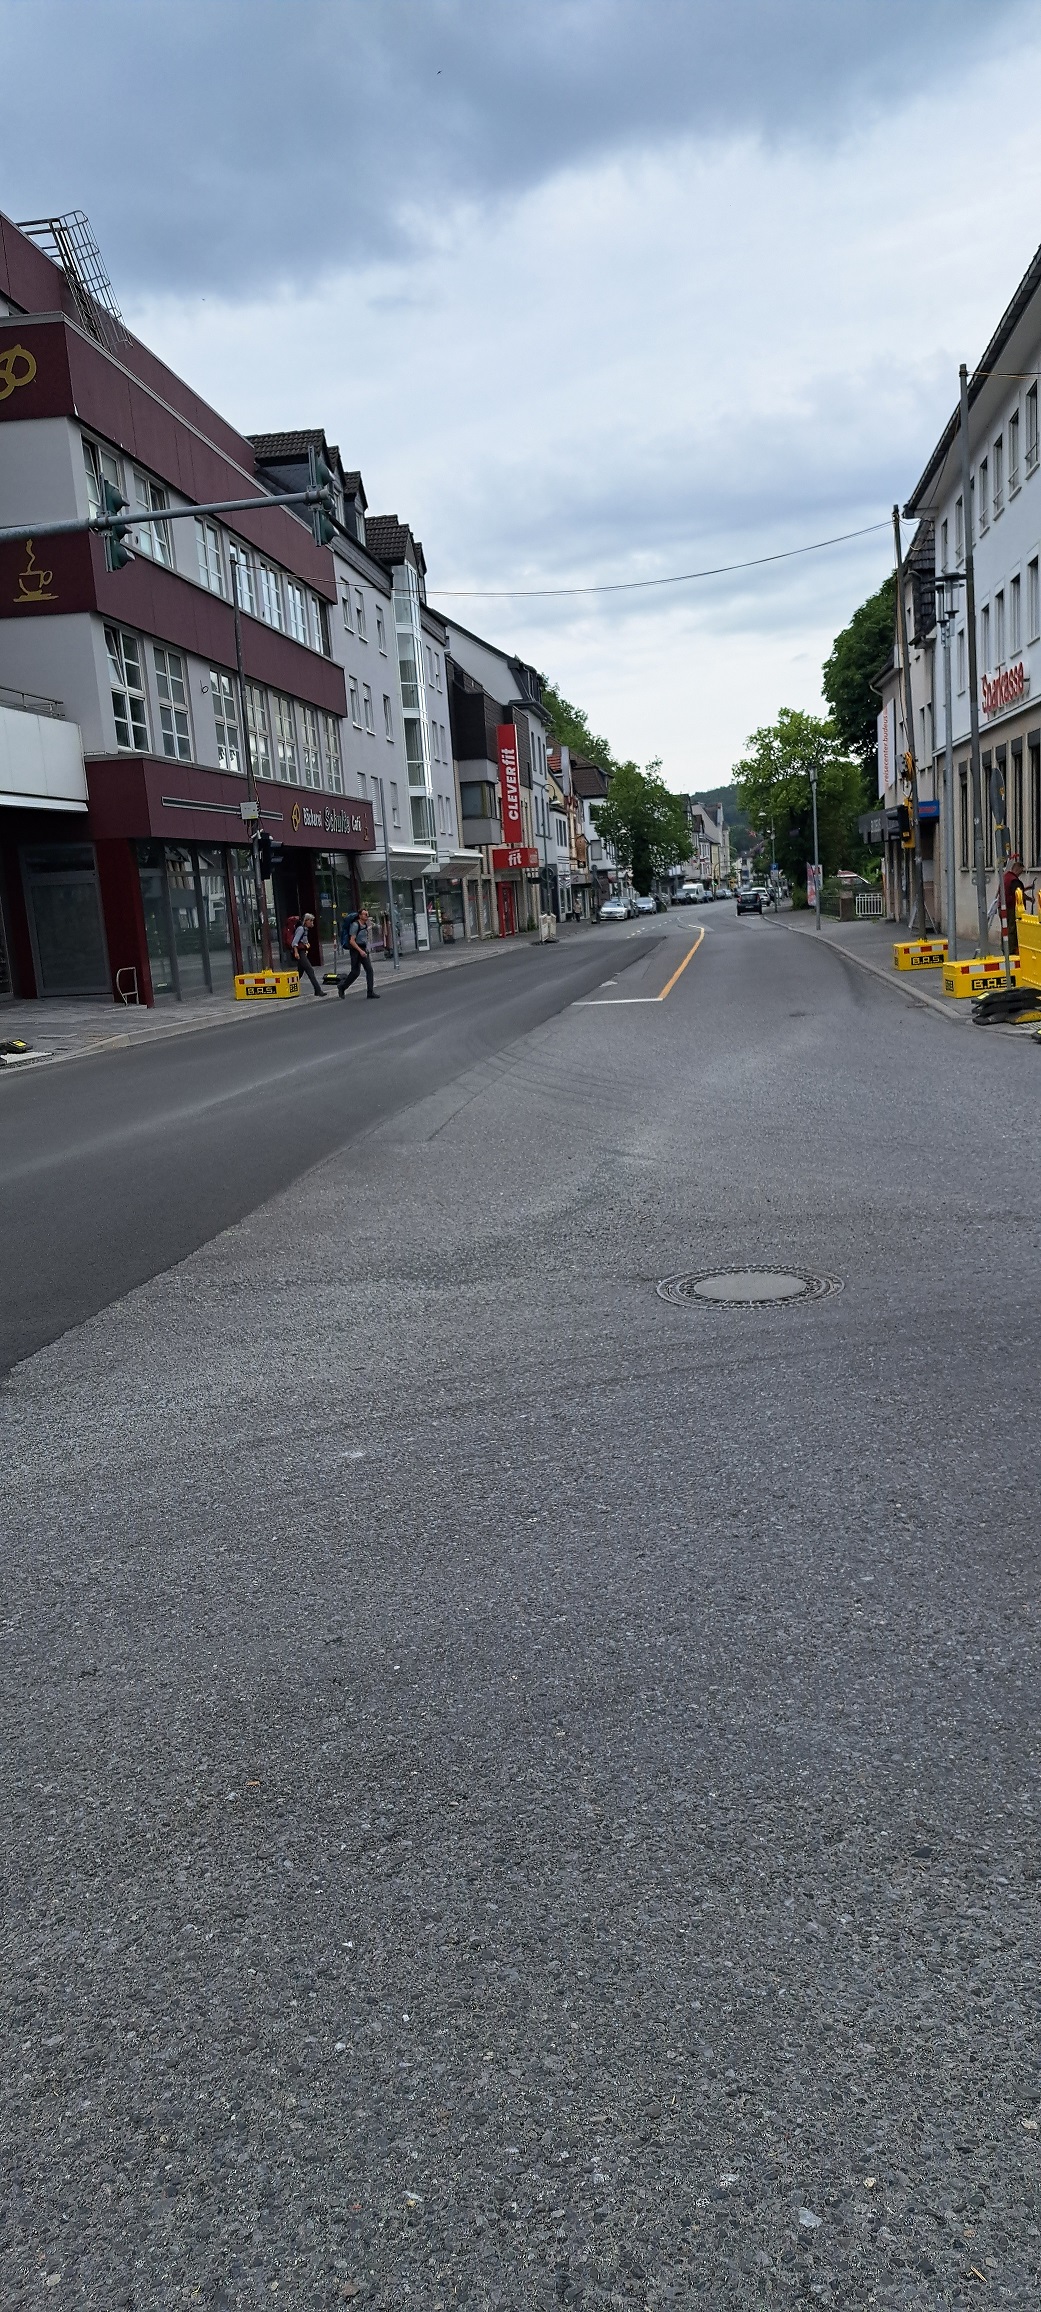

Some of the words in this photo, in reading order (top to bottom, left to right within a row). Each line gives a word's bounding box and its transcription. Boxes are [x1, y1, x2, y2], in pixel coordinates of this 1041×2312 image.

[981, 662, 1024, 716] Sparkasse
[508, 853, 522, 867] fit
[912, 955, 943, 965] B.A.S.
[247, 986, 276, 995] B.A.S.
